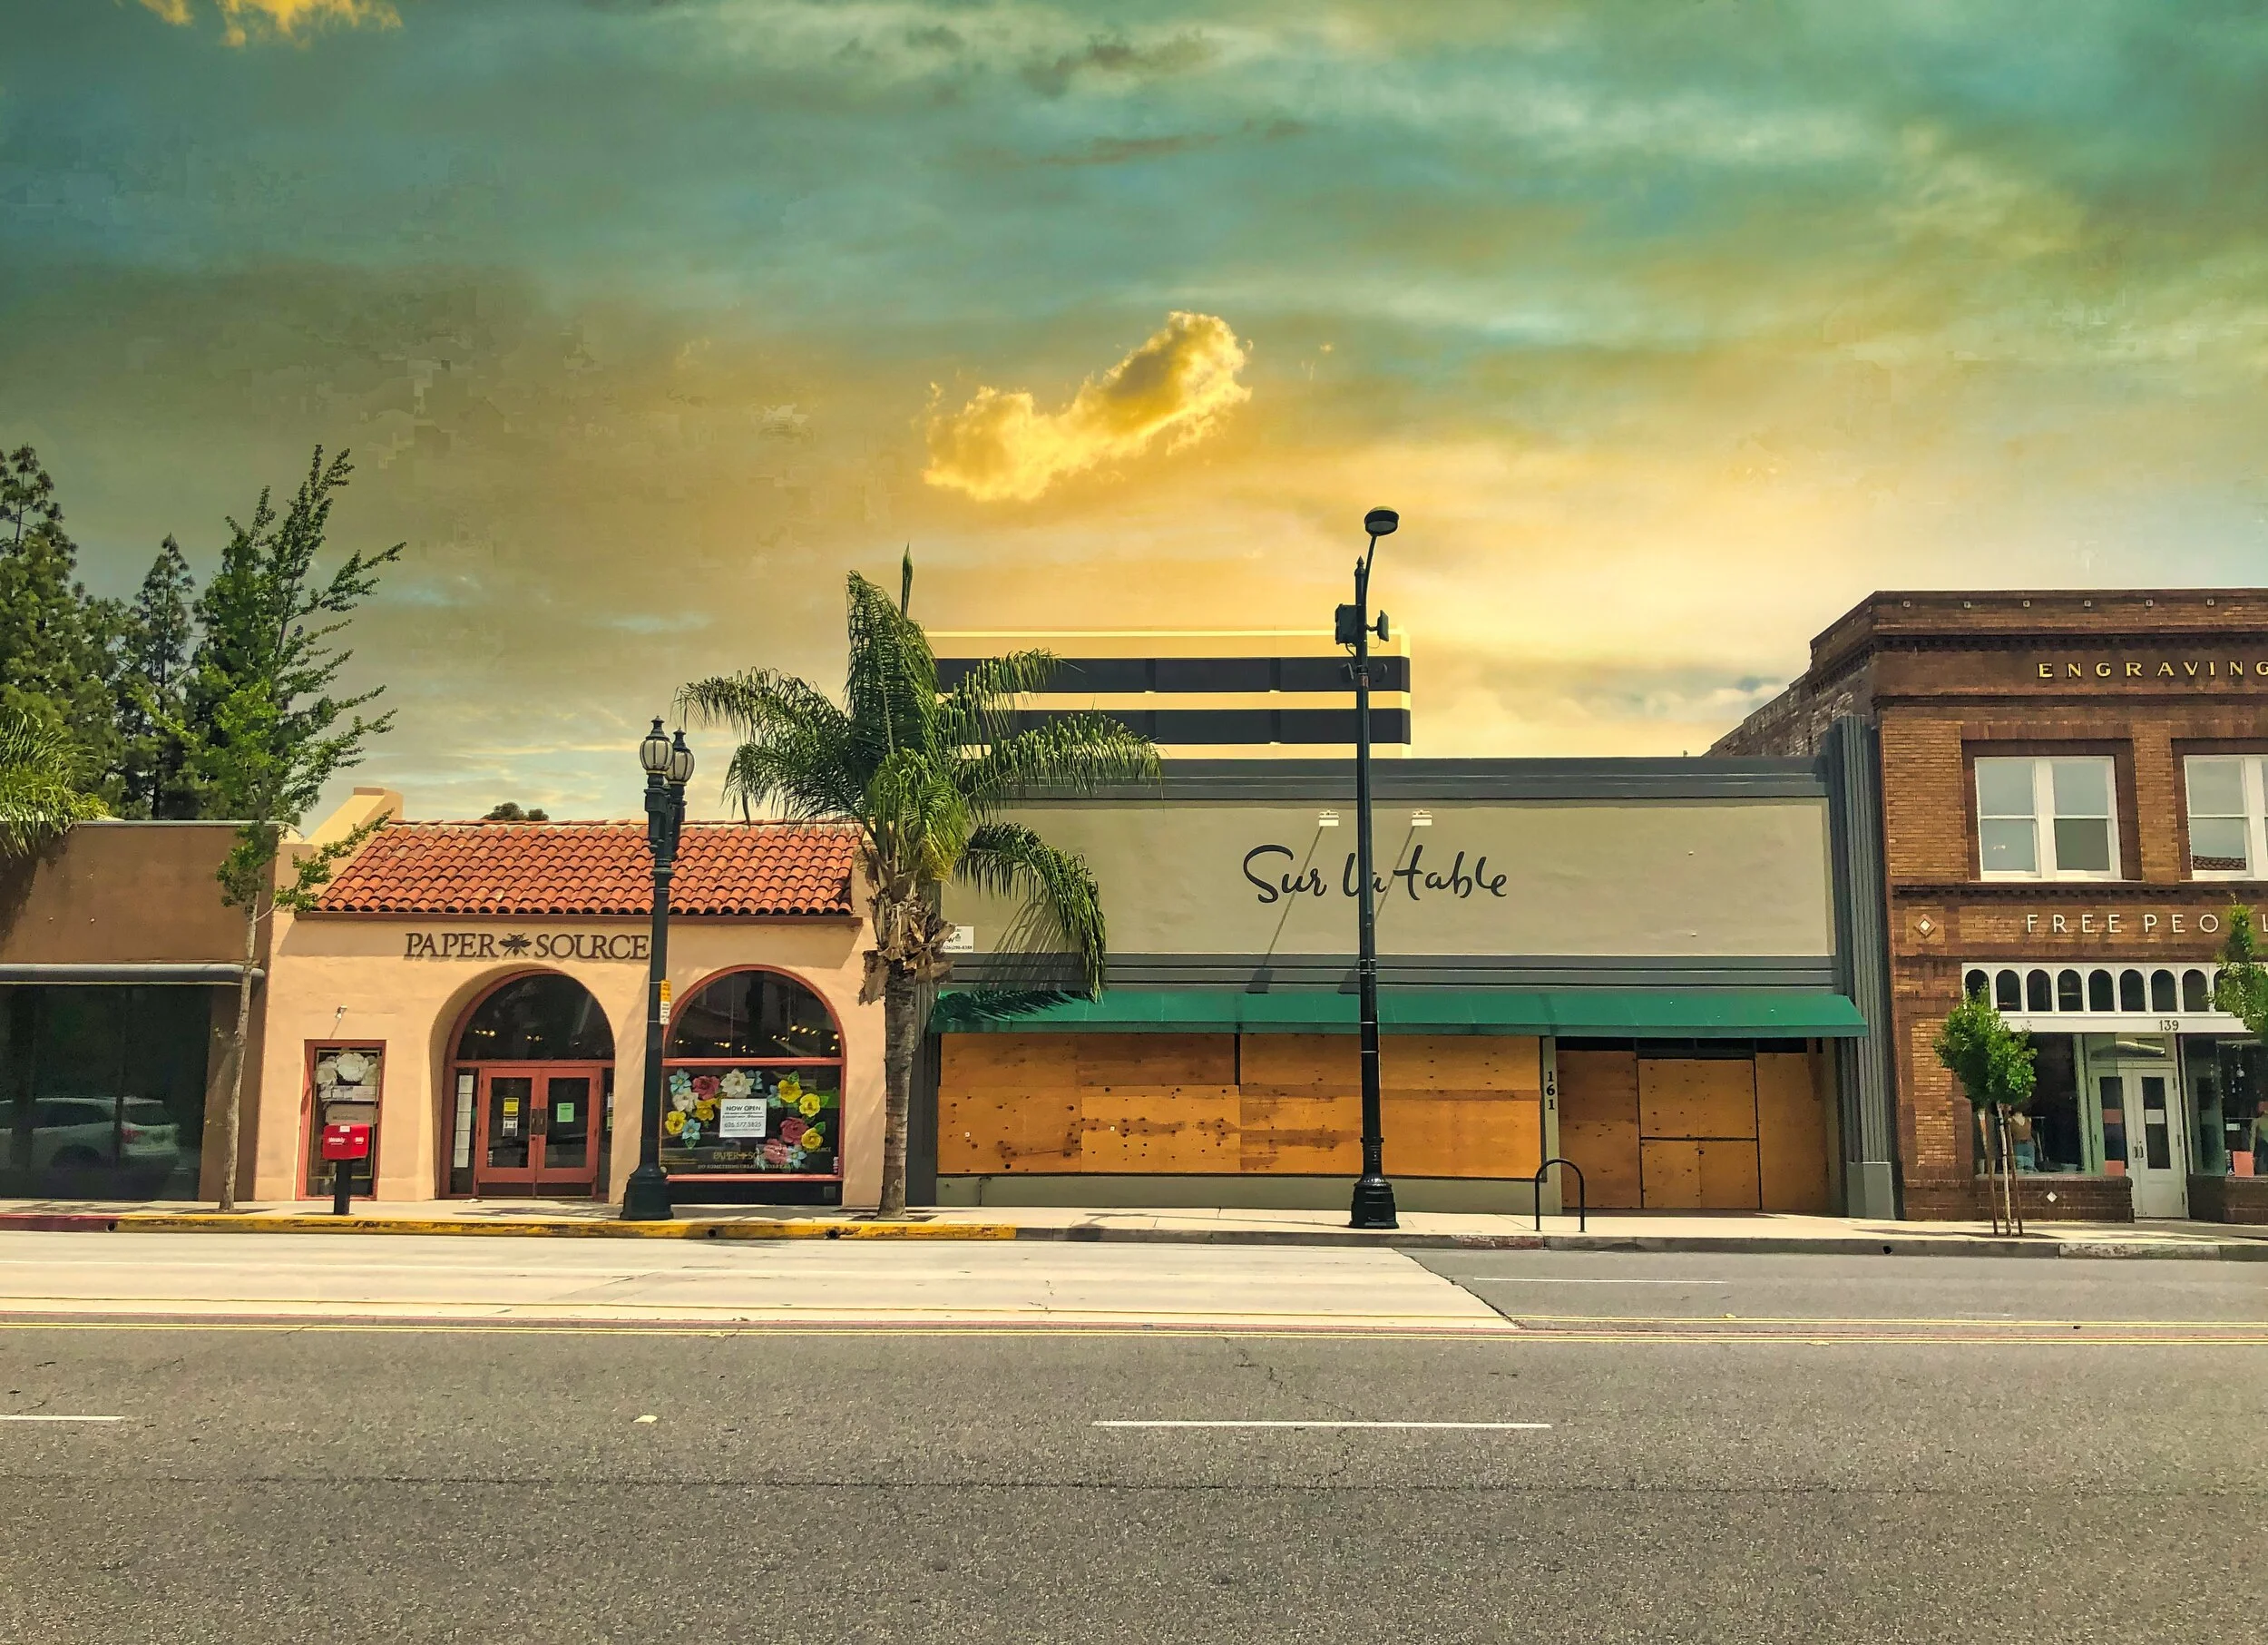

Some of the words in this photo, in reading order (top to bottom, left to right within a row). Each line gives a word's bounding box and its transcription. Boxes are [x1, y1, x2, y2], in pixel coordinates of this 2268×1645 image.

[2038, 661, 2268, 678] ENGRAVING
[1243, 844, 1327, 903] Sur
[1393, 844, 1507, 900] table
[2027, 914, 2122, 933] FREE
[2144, 914, 2268, 934] PEOL
[405, 932, 499, 959] PAPER
[533, 933, 650, 960] SOURCE
[2159, 1019, 2179, 1031] 139
[1546, 1071, 1555, 1111] 161
